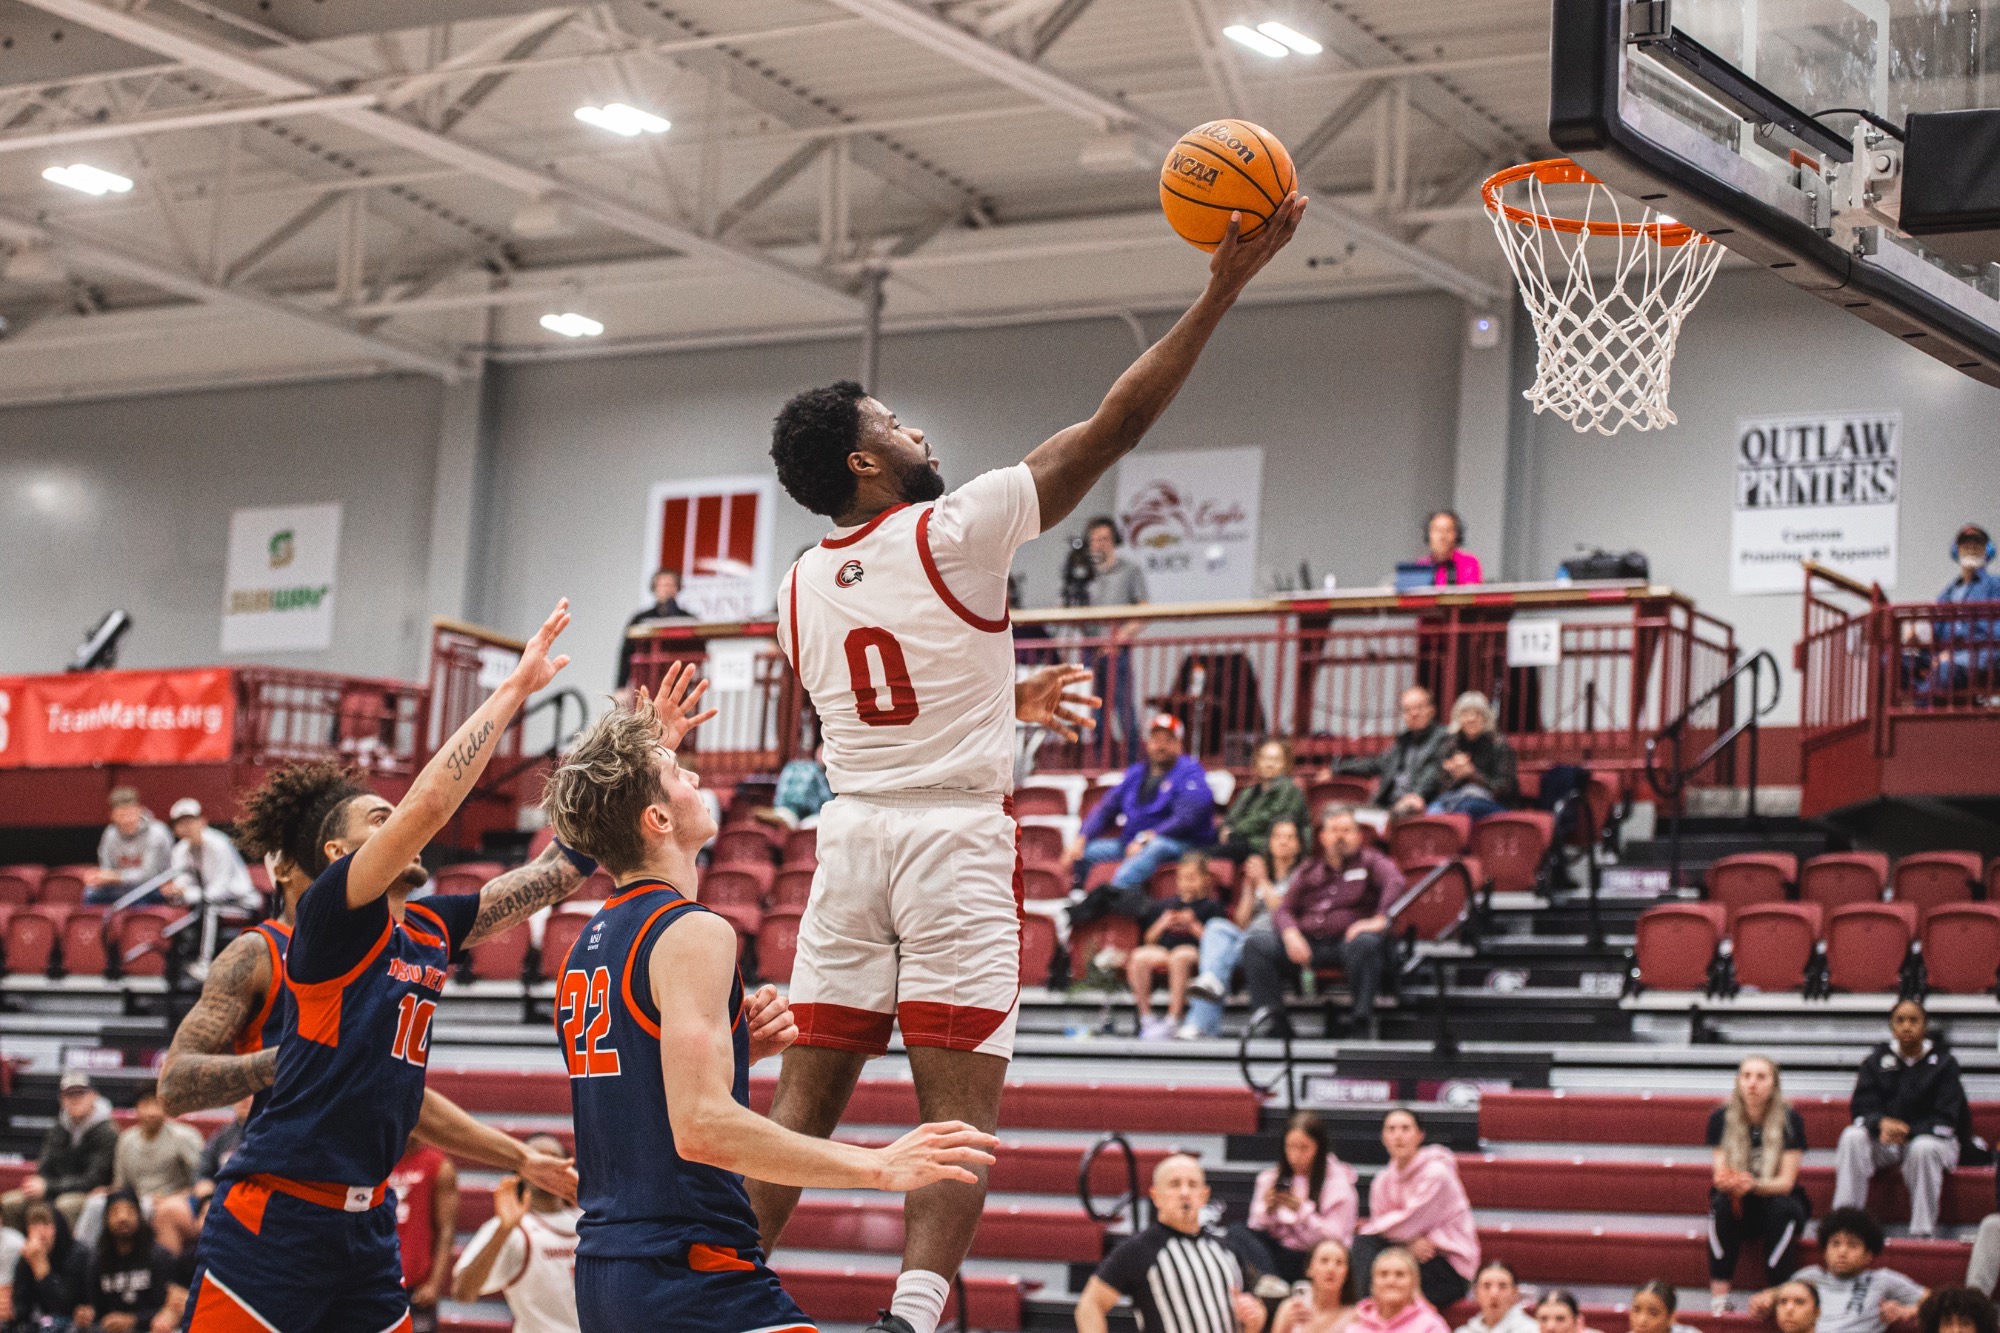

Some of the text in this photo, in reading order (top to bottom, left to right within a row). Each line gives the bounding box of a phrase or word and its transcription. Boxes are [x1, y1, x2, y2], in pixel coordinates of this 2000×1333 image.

[1168, 152, 1220, 187] NCAA
[1741, 423, 1896, 465] OUTLAW
[1738, 462, 1897, 507] PRINTERS
[1521, 632, 1550, 652] 112
[844, 627, 919, 726] 0
[48, 701, 223, 734] TeamMates.org
[447, 719, 494, 781] Helen
[391, 992, 437, 1068] 10
[561, 966, 621, 1078] 22
